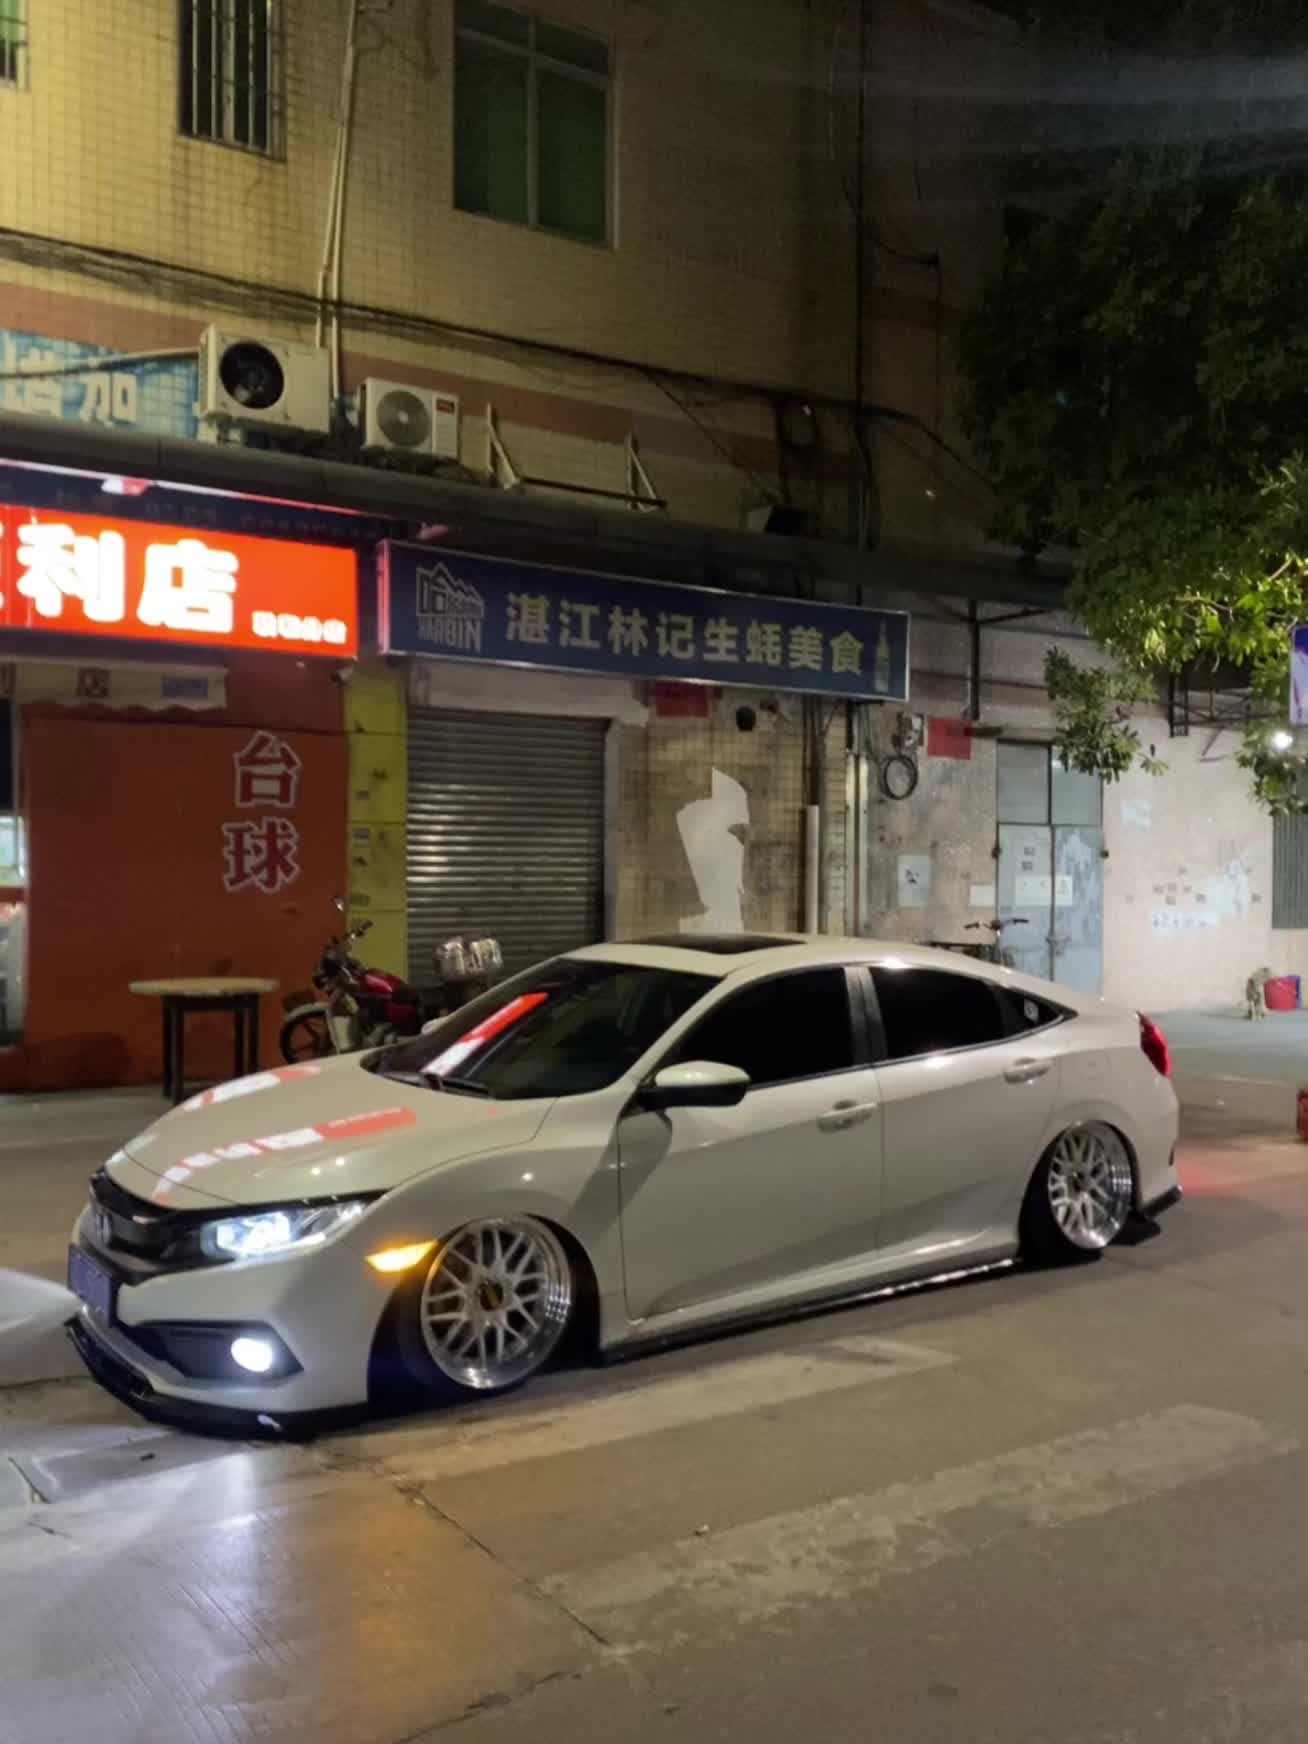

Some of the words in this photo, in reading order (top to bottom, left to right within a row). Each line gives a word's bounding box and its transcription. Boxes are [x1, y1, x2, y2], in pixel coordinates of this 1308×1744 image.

[0, 521, 240, 634] 利店
[505, 592, 864, 677] 湛江林记生蚝美食
[222, 730, 302, 894] 台球
